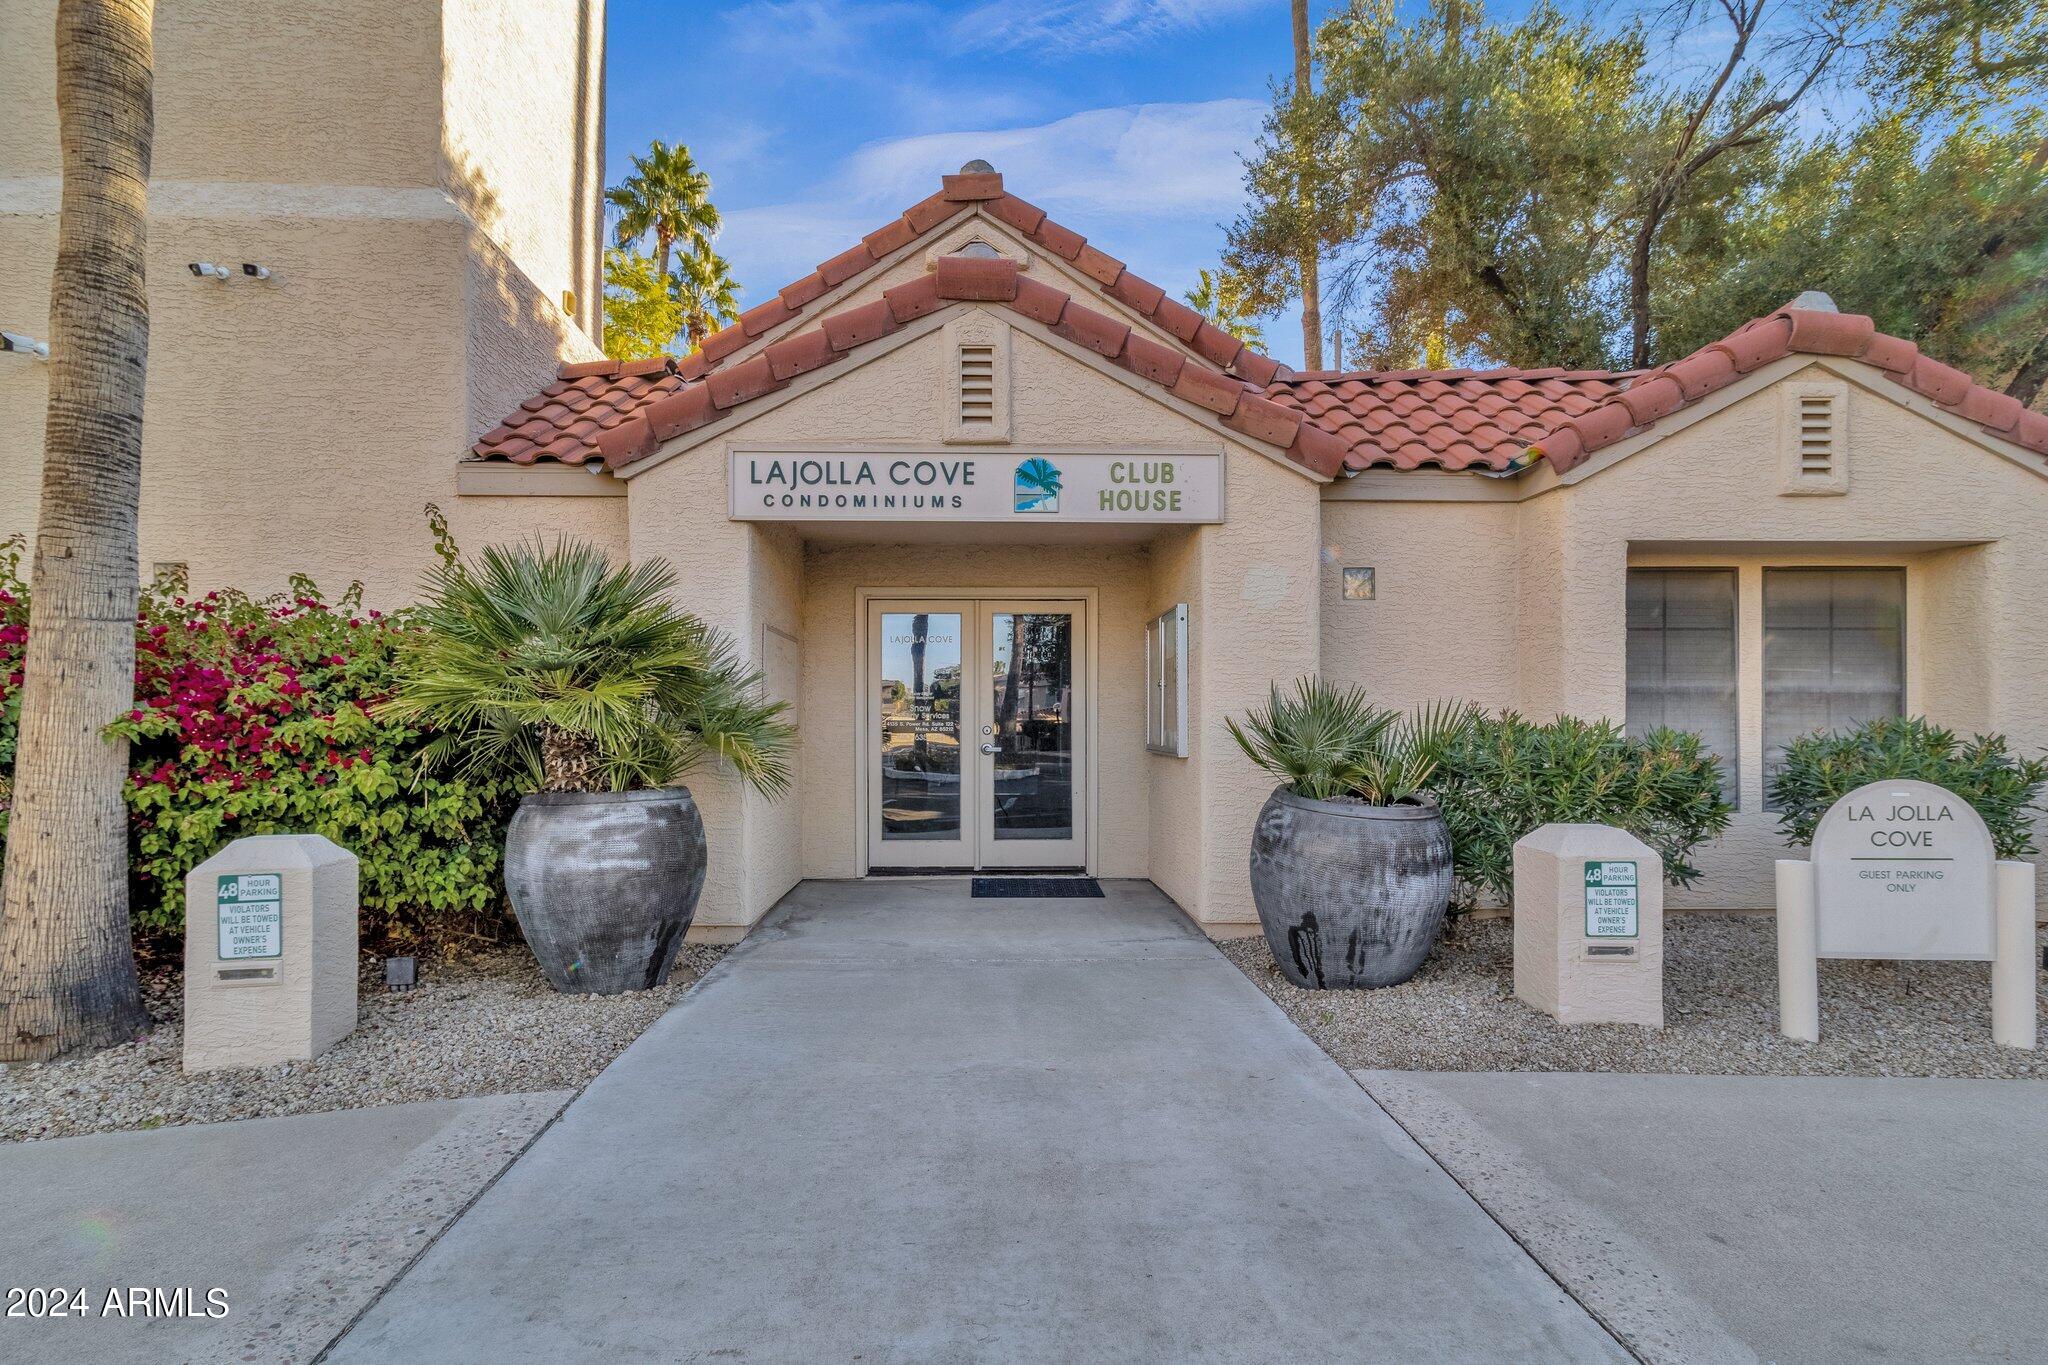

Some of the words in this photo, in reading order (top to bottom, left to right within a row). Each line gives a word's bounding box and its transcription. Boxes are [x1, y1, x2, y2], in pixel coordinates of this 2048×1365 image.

[751, 460, 877, 491] LAJOLLA
[888, 460, 976, 486] COVE
[1109, 461, 1175, 484] CLUB
[762, 493, 963, 508] CONDOMINIUMS
[1097, 489, 1183, 512] HOUSE
[928, 635, 953, 643] COVE
[909, 704, 931, 712] Snow
[1847, 805, 1875, 821] LA
[1885, 805, 1954, 821] JOLLA
[1870, 830, 1933, 847] COVE
[1585, 868, 1602, 882] 48
[1603, 874, 1635, 882] PARKING
[1608, 866, 1629, 874] HOUR
[1858, 870, 1891, 880] GUEST
[1896, 870, 1944, 880] PARKING
[218, 882, 238, 899] 48
[240, 888, 277, 896] PARKING
[1594, 888, 1629, 896] VIOLATORS
[1886, 883, 1917, 893] ONLY
[1587, 898, 1604, 906] WILL
[1604, 898, 1613, 906] BE
[1613, 898, 1636, 906] TOWED
[229, 904, 270, 914] VIOLATORS
[1594, 907, 1604, 915] AT
[1603, 907, 1629, 915] VEHICLE
[220, 915, 240, 924] WILL
[240, 915, 252, 924] BE
[252, 914, 279, 924] TOWED
[1597, 916, 1626, 925] OWNER'S
[229, 925, 240, 935] AT
[240, 924, 271, 934] VEHICLE
[1597, 925, 1626, 934] EXPENSE
[233, 935, 267, 945] OWNER'S
[233, 945, 267, 955] EXPENSE
